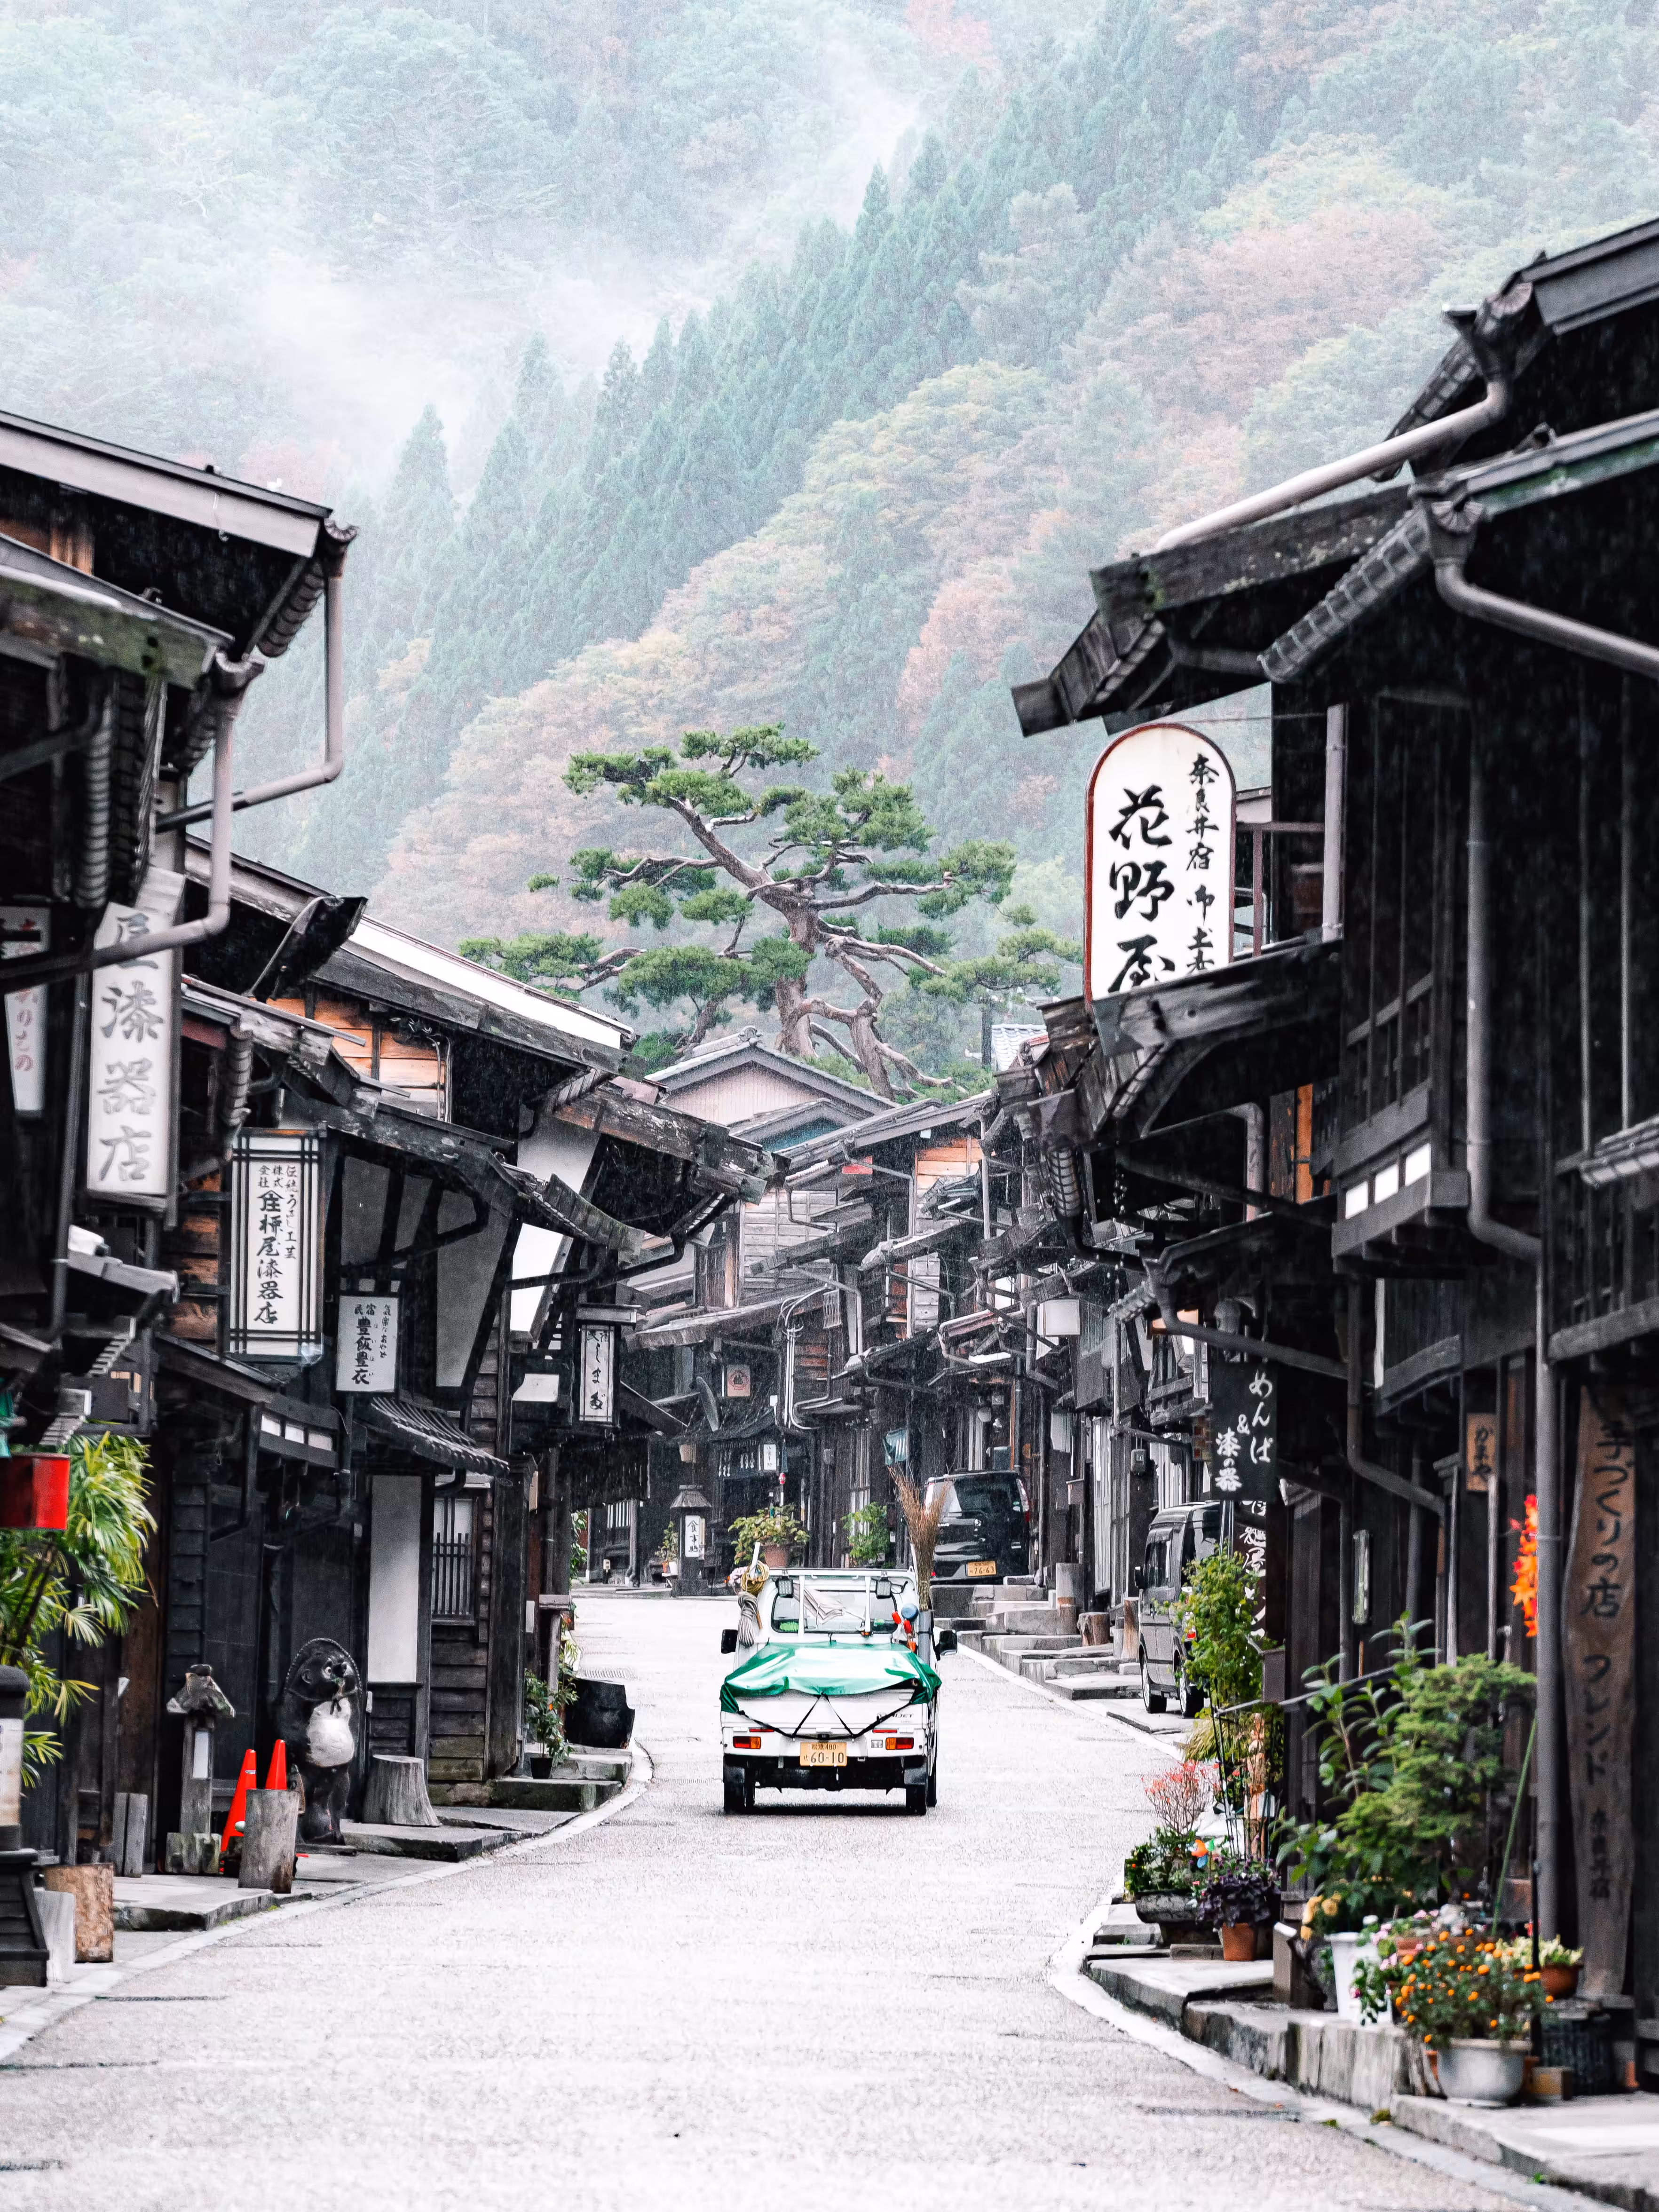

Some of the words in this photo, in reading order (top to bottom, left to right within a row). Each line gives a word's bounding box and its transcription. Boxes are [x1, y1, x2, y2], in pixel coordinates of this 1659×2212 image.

[1108, 784, 1175, 993] 花野屋
[1215, 1426, 1242, 1492] 漆の器
[810, 1752, 844, 1763] 60-10
